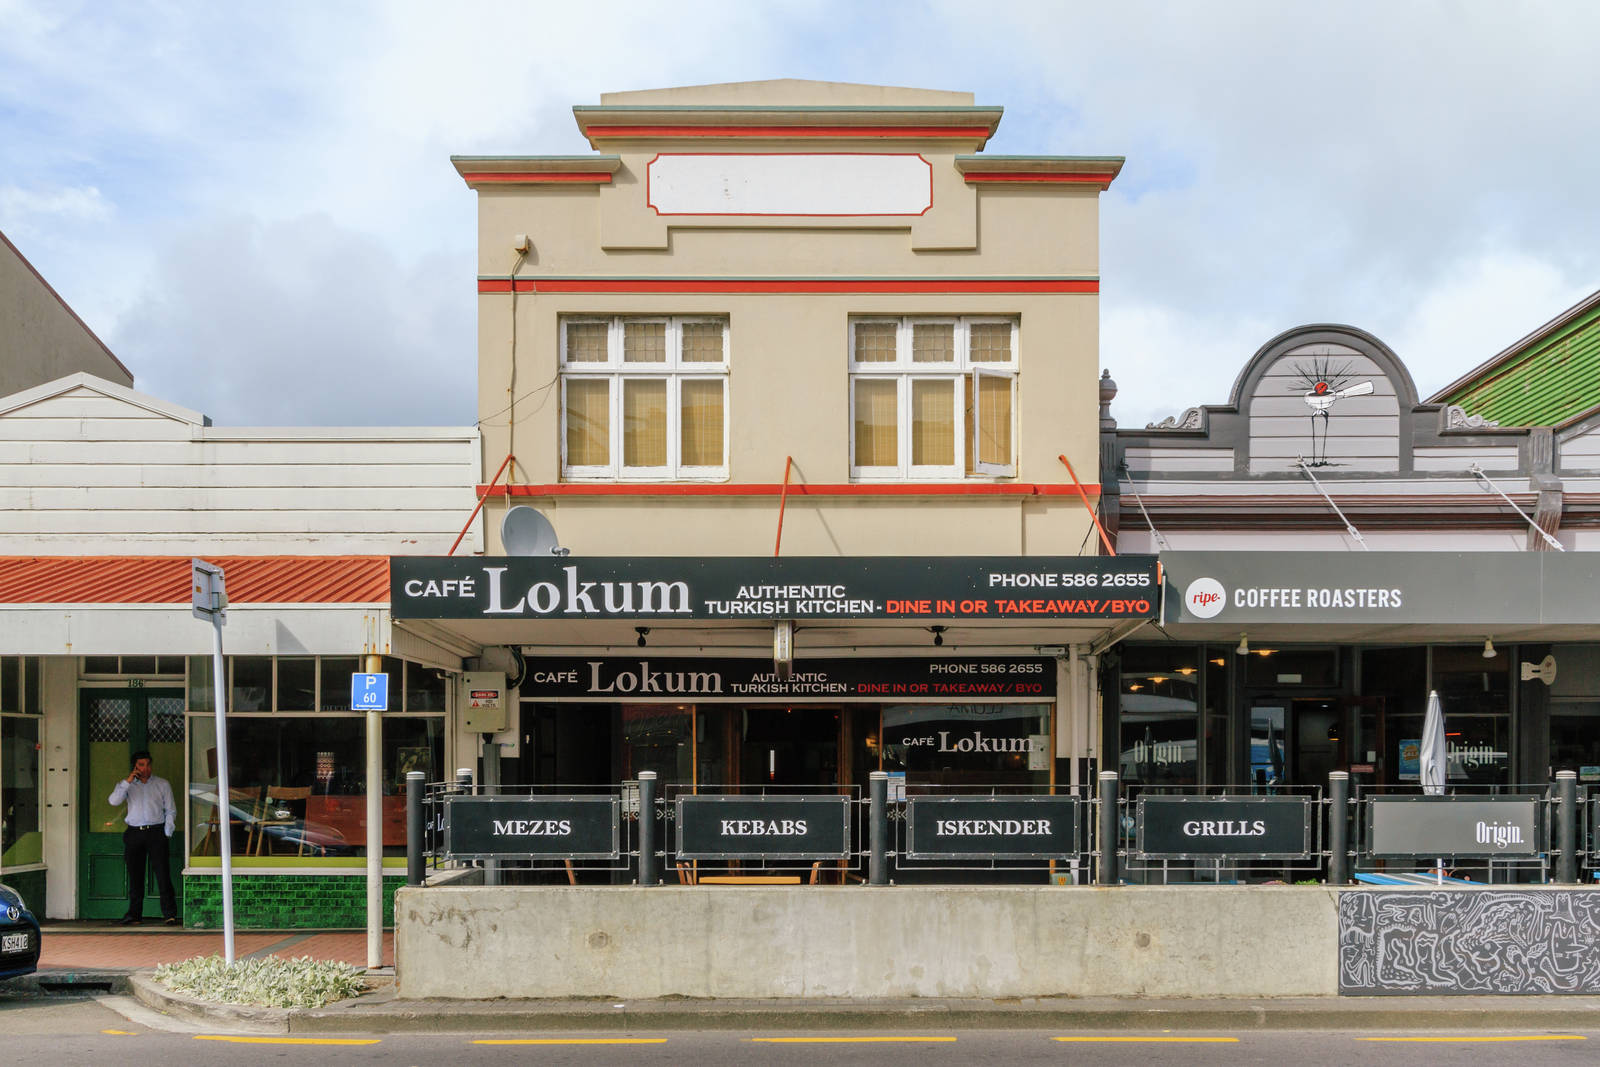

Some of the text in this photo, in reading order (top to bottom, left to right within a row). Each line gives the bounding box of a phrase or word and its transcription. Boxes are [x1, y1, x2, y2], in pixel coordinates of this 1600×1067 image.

[989, 573, 1151, 587] PHONE 586 2655
[404, 566, 693, 614] CAFÉ Lokum
[736, 585, 846, 599] AUTHENTIC
[1234, 588, 1402, 608] COFFEE ROASTERS
[704, 600, 789, 614] TURKISH
[886, 600, 932, 614] DINE
[936, 600, 956, 614] IN
[959, 600, 988, 614] OR
[534, 661, 724, 693] CAFÉ Lokum
[929, 664, 1043, 673] PHONE 586 2655
[366, 676, 377, 690] P
[751, 672, 827, 683] AUTENTIC
[731, 683, 789, 693] TURKISH
[792, 683, 847, 693] KITCHEN
[857, 683, 889, 693] DINE
[893, 683, 906, 693] IN
[909, 683, 928, 693] OR
[1015, 683, 1042, 693] BYO
[363, 692, 377, 703] 60
[902, 731, 1034, 752] CAFÉ Lokum
[493, 819, 571, 836] MEZES
[720, 819, 807, 836] KEBABS
[936, 819, 1052, 836] ISKENDER
[1182, 820, 1266, 837] GRILLS
[1475, 821, 1525, 849] Origin.
